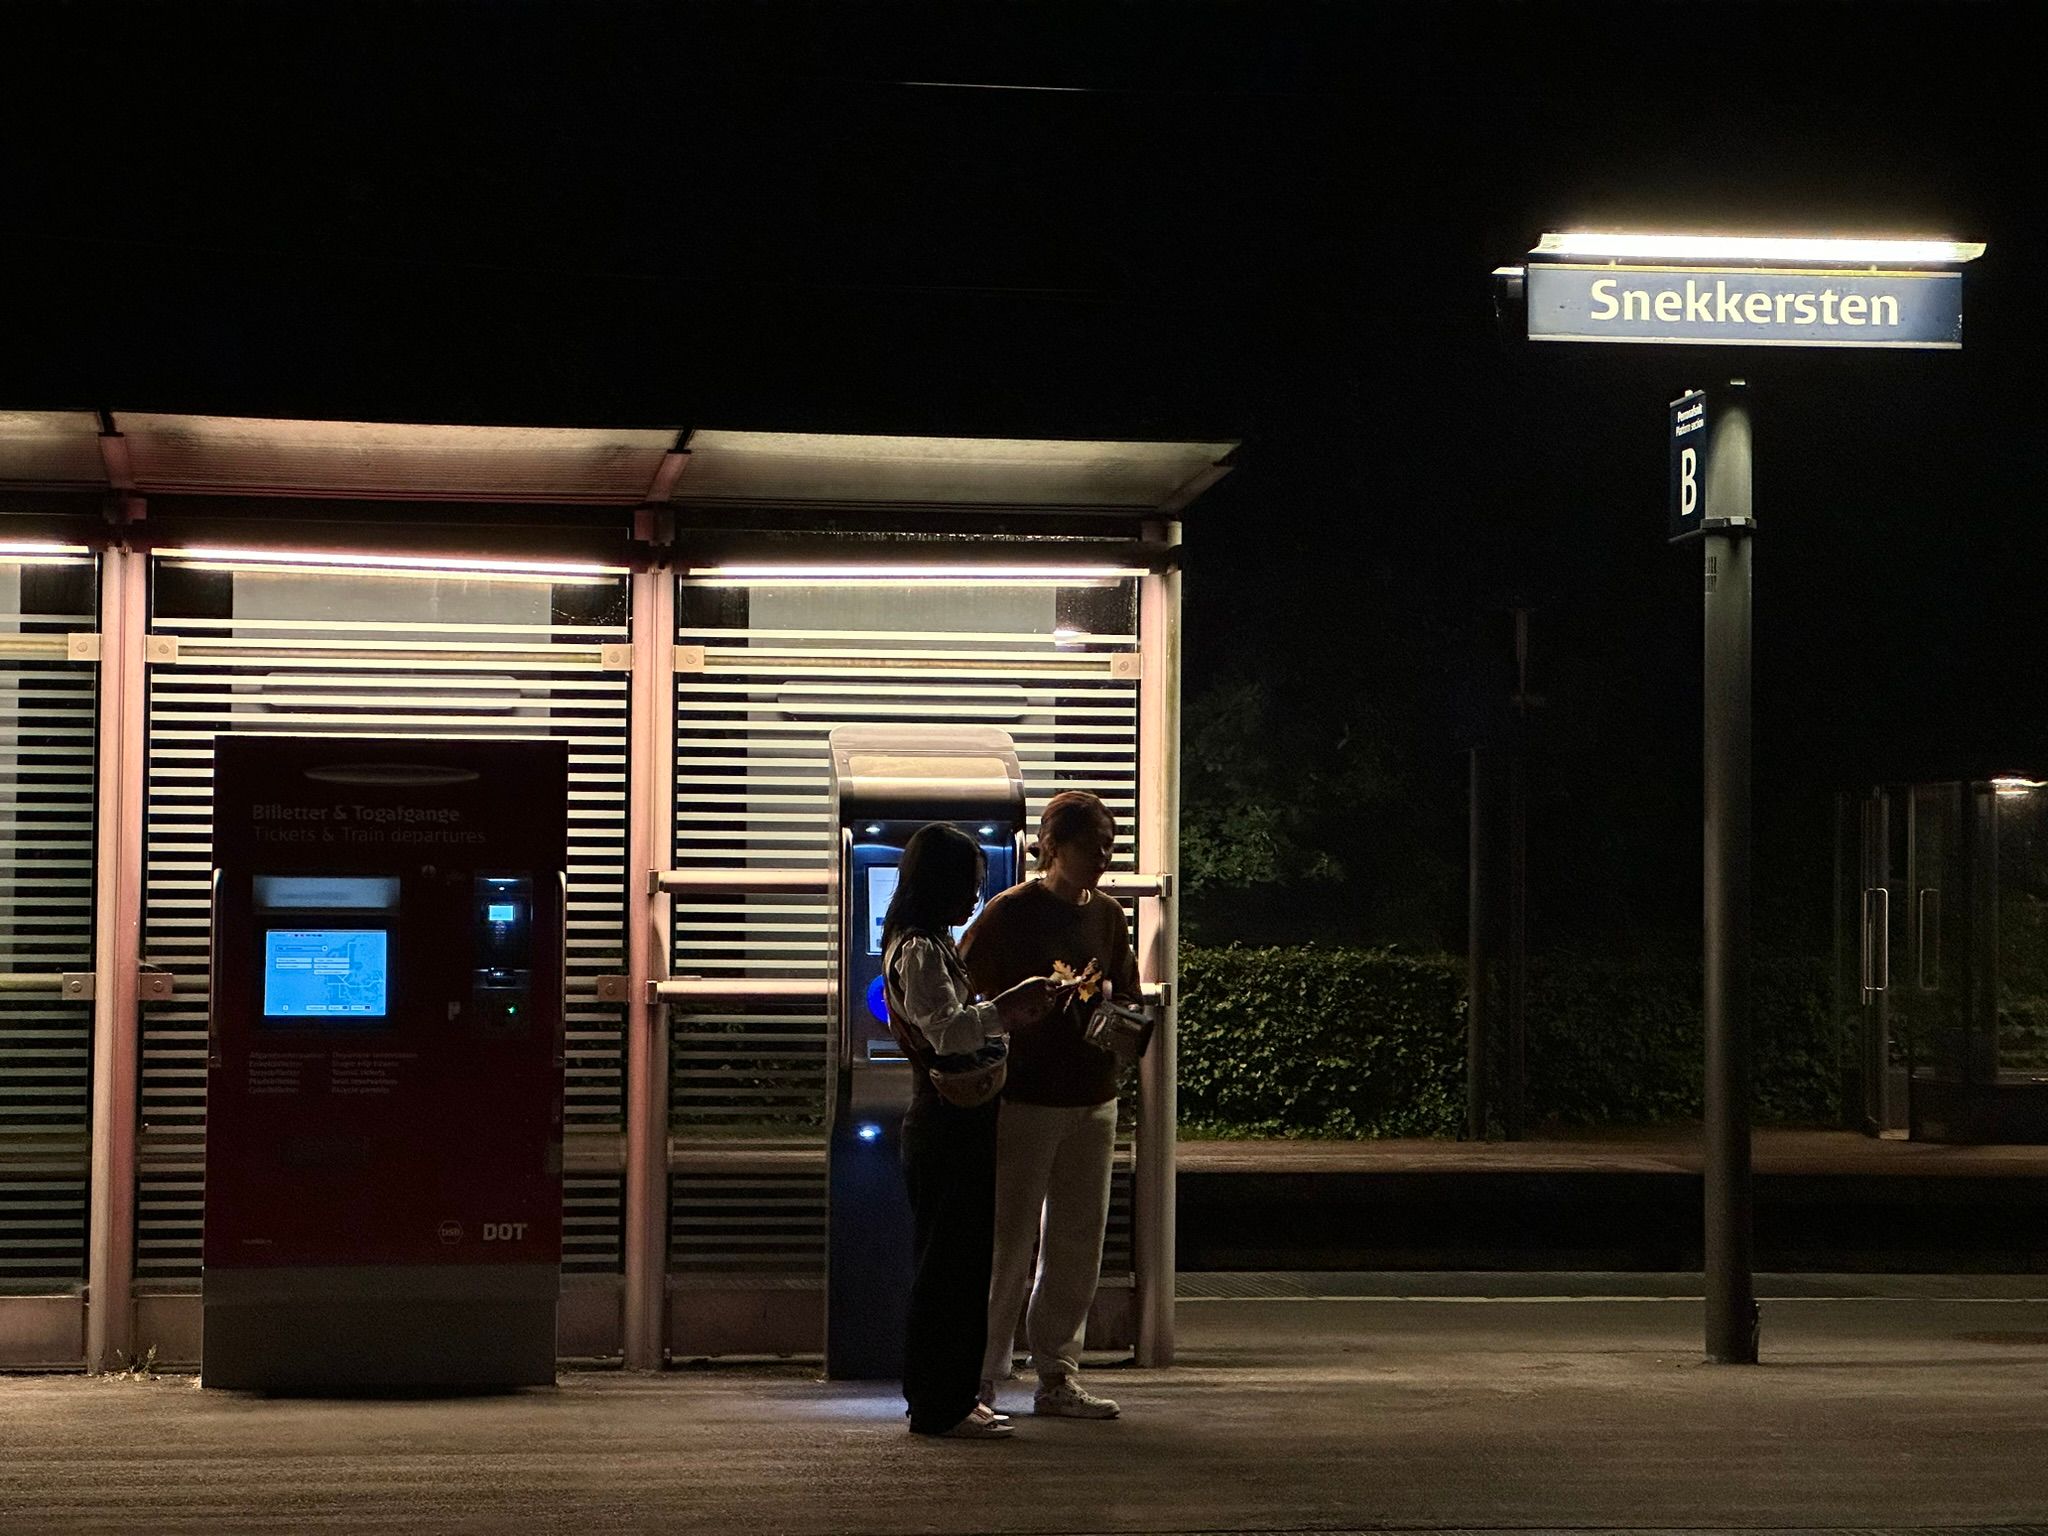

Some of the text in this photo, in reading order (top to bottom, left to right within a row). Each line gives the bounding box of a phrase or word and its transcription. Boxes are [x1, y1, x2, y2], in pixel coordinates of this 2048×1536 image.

[1589, 279, 1899, 327] Snekkersten
[1681, 447, 1698, 517] B
[252, 804, 329, 821] Billetter
[332, 805, 348, 821] &
[253, 826, 487, 846] Tickets & Train departures
[482, 1223, 529, 1241] DOT
